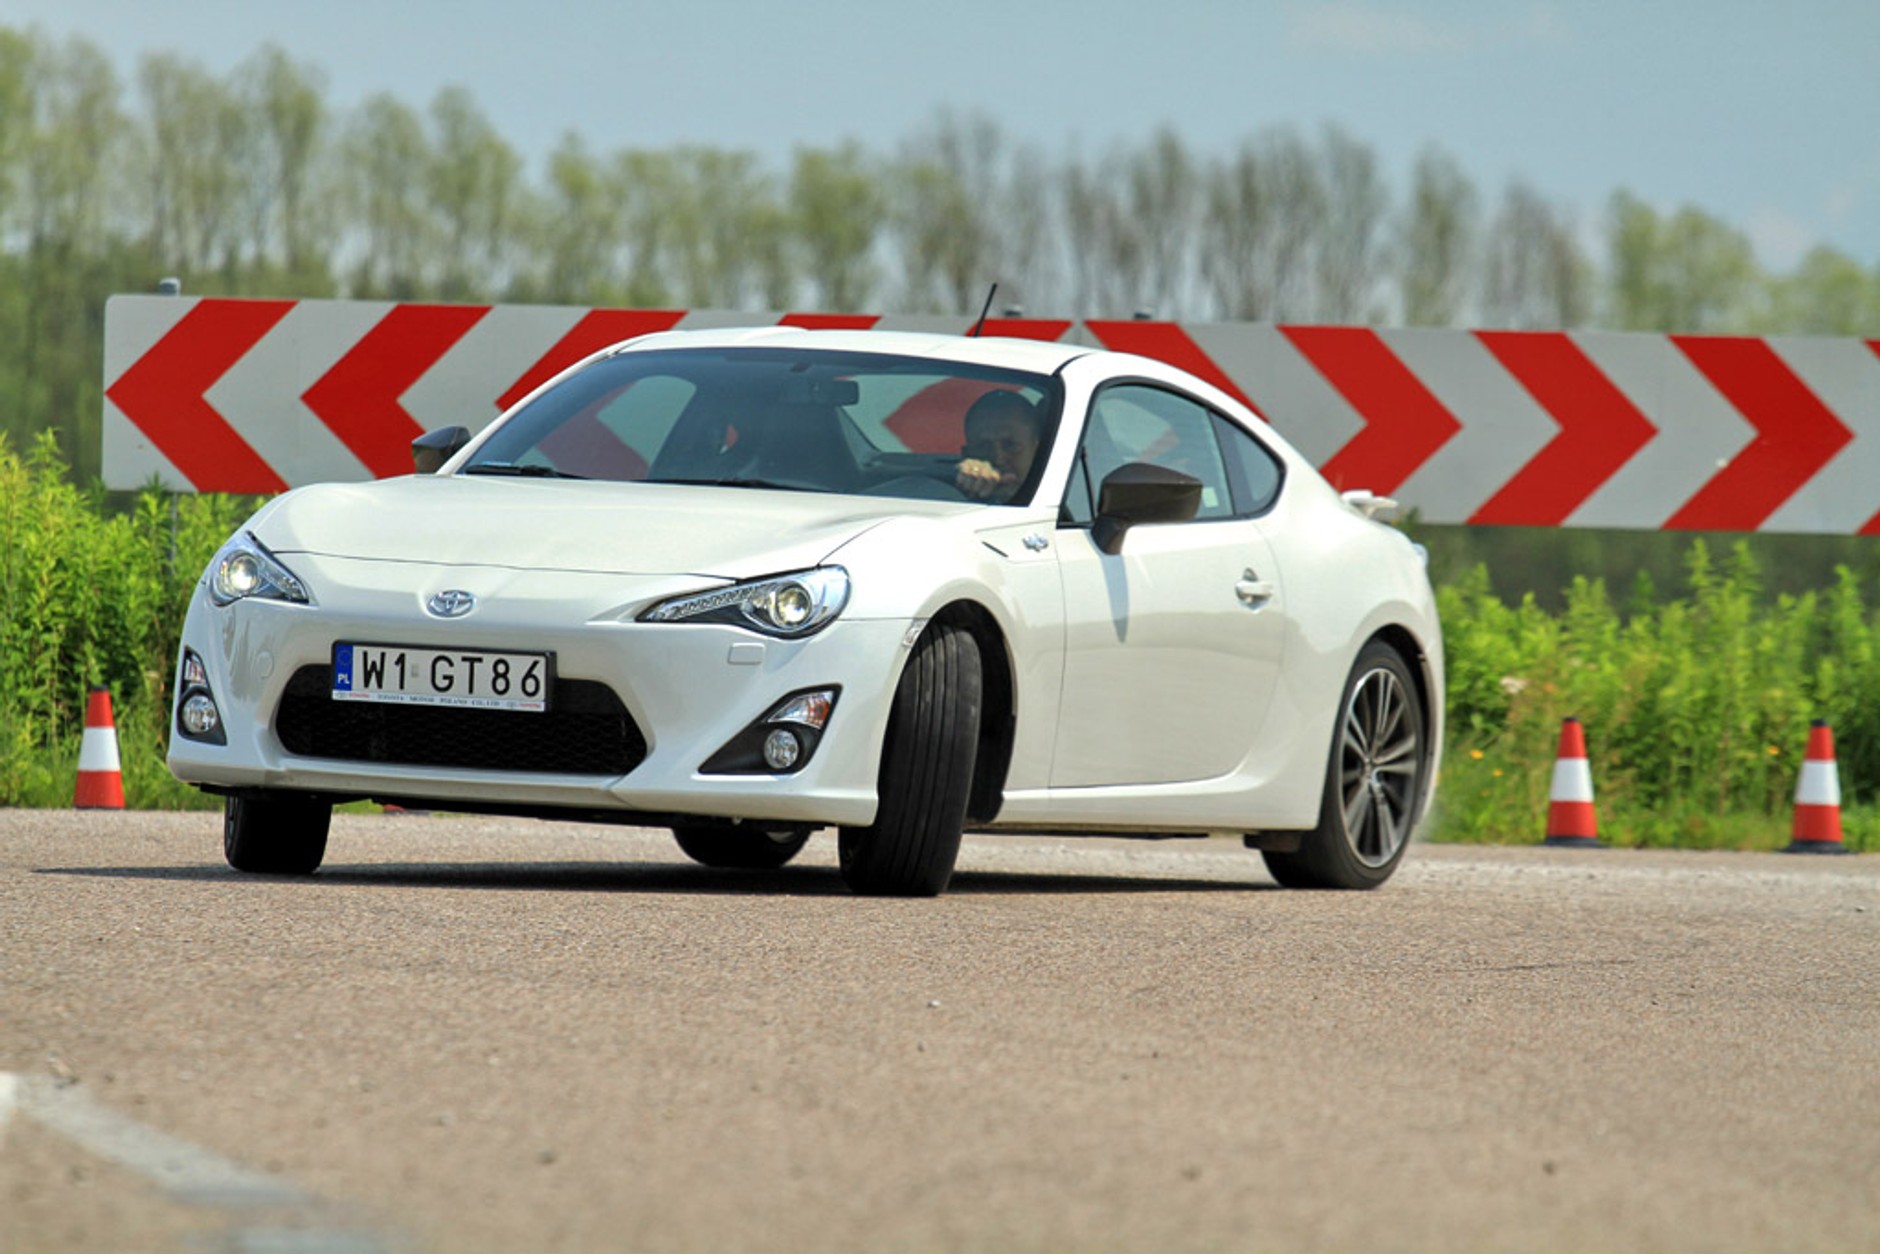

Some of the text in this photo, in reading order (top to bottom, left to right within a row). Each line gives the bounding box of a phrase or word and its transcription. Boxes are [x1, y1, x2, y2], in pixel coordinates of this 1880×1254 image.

[337, 673, 350, 684] PL
[362, 650, 540, 697] W1 GT86
